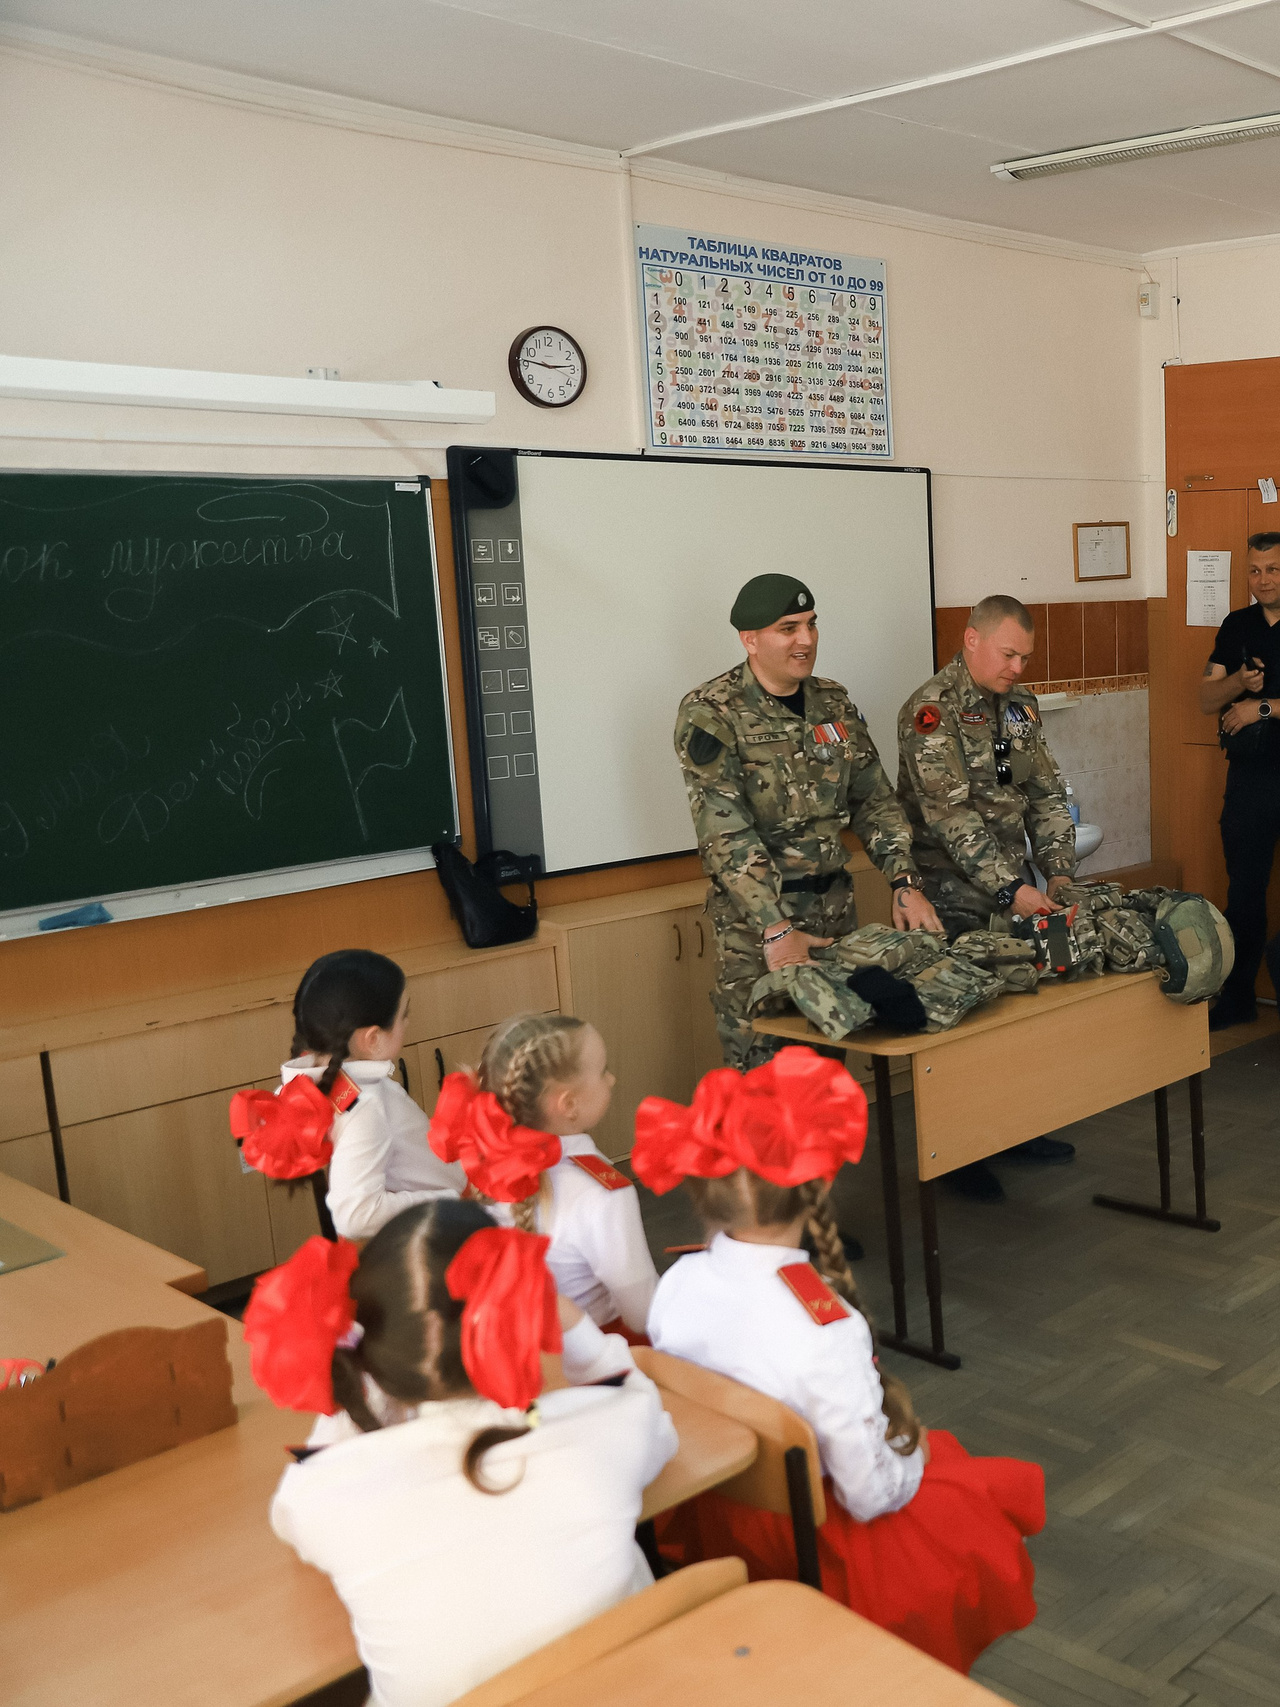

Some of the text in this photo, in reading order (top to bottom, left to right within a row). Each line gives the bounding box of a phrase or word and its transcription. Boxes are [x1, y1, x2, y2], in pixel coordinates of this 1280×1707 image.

[687, 236, 842, 270] ТАБЛИЦА КВАДРАТОВ
[639, 246, 754, 274] НАТУРАЛЬНЫХ
[757, 264, 804, 281] ЧИСЕЛ
[808, 271, 826, 283] ОТ
[830, 274, 844, 286] 10
[847, 277, 866, 290] ДО
[870, 280, 883, 291] 99
[674, 271, 683, 287] 0
[700, 275, 706, 290] 1
[720, 278, 729, 293] 2
[743, 280, 752, 295] 3
[766, 284, 773, 298] 4
[787, 287, 794, 301] 5
[809, 289, 816, 304] 6
[830, 292, 836, 306] 7
[850, 294, 856, 308] 8
[869, 297, 876, 310] 9
[654, 293, 659, 305] 1
[674, 297, 686, 305] 100
[698, 300, 711, 309] 121
[722, 303, 734, 311] 144
[744, 305, 755, 313] 169
[765, 308, 777, 316] 196
[786, 310, 798, 319] 225
[808, 313, 819, 321] 256
[828, 315, 839, 323] 289
[654, 310, 859, 342] 2 400 484 529 576 625 729 784
[535, 339, 541, 349] 11
[544, 336, 553, 347] 12
[655, 327, 662, 340] 3
[675, 332, 688, 340] 900
[700, 335, 712, 343] 961
[720, 337, 736, 345] 1024
[742, 339, 758, 347] 1089
[764, 341, 779, 349] 1156
[785, 343, 801, 351] 1225
[826, 347, 842, 355] 1369
[847, 349, 861, 357] 1444
[869, 351, 882, 359] 1521
[526, 347, 536, 358] 10
[565, 351, 571, 361] 2
[655, 345, 662, 357] 4
[674, 350, 692, 358] 1600
[698, 352, 714, 360] 1681
[721, 354, 738, 362] 1764
[743, 355, 759, 363] 1849
[765, 358, 780, 366] 1936
[786, 360, 801, 368] 2025
[807, 361, 822, 369] 2116
[827, 363, 843, 371] 2209
[848, 365, 862, 373] 2304
[523, 361, 529, 370] 9
[570, 365, 575, 374] 3
[528, 374, 534, 384] 8
[656, 363, 663, 375] 5
[675, 367, 693, 375] 2500
[698, 369, 715, 377] 2601
[765, 374, 781, 382] 2916
[786, 376, 802, 384] 3025
[537, 384, 542, 393] 7
[566, 378, 572, 387] 4
[548, 389, 554, 398] 6
[559, 386, 565, 396] 5
[657, 381, 664, 393] 6
[676, 384, 693, 392] 3600
[699, 385, 716, 393] 3721
[723, 387, 739, 395] 3844
[745, 388, 761, 396] 3969
[766, 390, 782, 398] 4096
[809, 393, 824, 401] 4356
[829, 395, 844, 403] 4489
[849, 396, 864, 404] 4624
[658, 398, 664, 410] 7
[677, 402, 695, 410] 4900
[724, 404, 740, 412] 5184
[746, 406, 762, 414] 5329
[767, 407, 783, 415] 5476
[850, 412, 865, 420] 6084
[870, 413, 884, 421] 6241
[658, 414, 665, 427] 8
[678, 418, 696, 426] 6400
[725, 421, 741, 429] 6724
[747, 422, 763, 430] 6889
[660, 432, 667, 444] 9
[679, 435, 697, 443] 8100
[703, 436, 719, 444] 8281
[726, 437, 742, 445] 8464
[748, 438, 764, 446] 8649
[769, 439, 785, 447] 8836
[753, 734, 780, 742] ГРОМ
